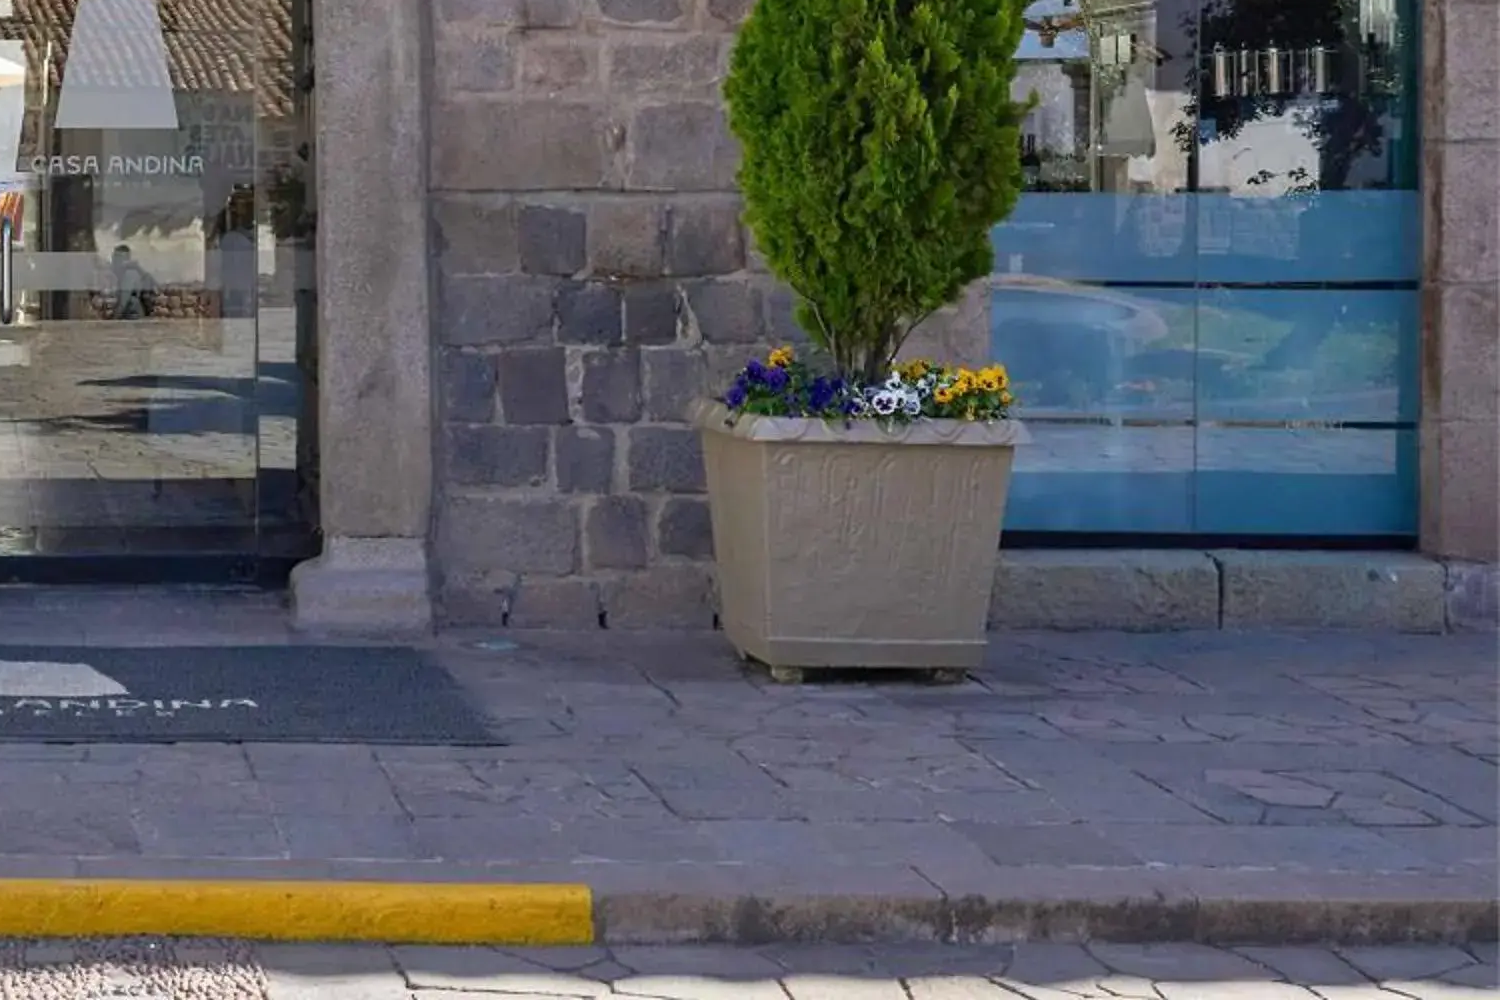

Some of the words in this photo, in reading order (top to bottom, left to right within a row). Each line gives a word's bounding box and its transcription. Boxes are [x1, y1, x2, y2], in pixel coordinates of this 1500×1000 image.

[31, 155, 99, 175] CASA
[107, 155, 204, 175] ANDINA
[13, 698, 258, 710] ANDINA
